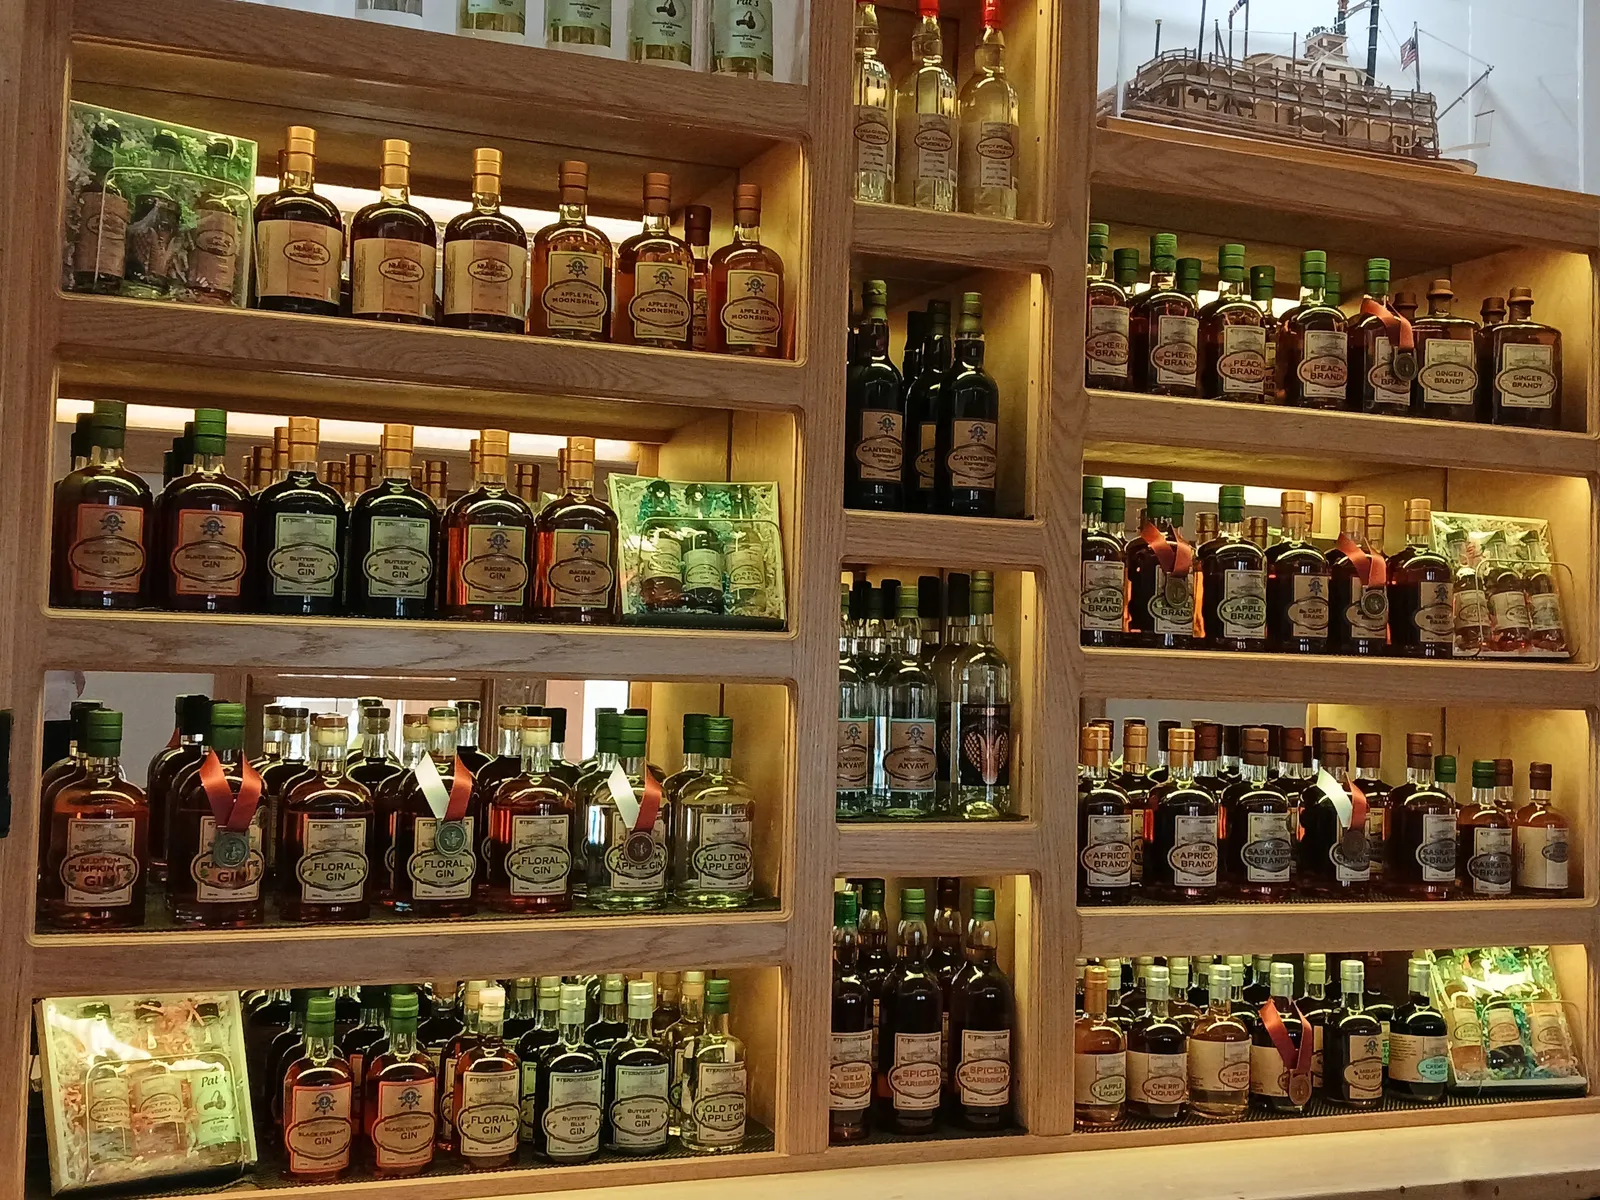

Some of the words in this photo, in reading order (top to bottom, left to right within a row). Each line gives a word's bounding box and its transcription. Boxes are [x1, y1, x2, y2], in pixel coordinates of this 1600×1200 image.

[561, 291, 581, 299] APPLE
[552, 297, 599, 307] MOONSHINE
[648, 301, 666, 309] APPLE
[639, 307, 684, 317] MOONSHINE
[731, 314, 775, 322] MOONSHINE
[1233, 360, 1262, 368] PEACH
[1313, 364, 1343, 373] PEACH
[101, 556, 120, 565] GIN
[289, 555, 323, 563] BUTTERFLY
[384, 558, 417, 566] BUTTERFLY
[202, 560, 220, 568] GIN
[297, 568, 316, 576] GIN
[391, 571, 409, 579] GIN
[489, 572, 506, 580] GIN
[574, 575, 591, 583] GIN
[1092, 596, 1120, 604] APPLE
[1161, 608, 1192, 617] BRAND
[1234, 605, 1263, 613] APPLE
[521, 855, 561, 865] FLORAL
[706, 853, 727, 862] OLD
[728, 853, 748, 861] TOM
[68, 863, 114, 873] PUMPKIN
[115, 864, 132, 872] PIE
[313, 862, 357, 872] FLORAL
[424, 859, 465, 869] FLORAL
[649, 860, 663, 870] GIN
[701, 862, 734, 871] APPLE
[735, 861, 750, 871] GIN
[435, 868, 455, 878] GIN
[532, 865, 551, 875] GIN
[84, 875, 116, 887] GIN
[217, 871, 249, 884] GIN
[325, 872, 346, 882] GIN
[902, 1069, 938, 1078] SPICED
[970, 1066, 1007, 1075] SPICED
[706, 1105, 726, 1113] OLD
[728, 1103, 745, 1112] TOM
[470, 1114, 512, 1125] FLORAL
[701, 1114, 733, 1122] APPLE
[634, 1119, 651, 1128] GIN
[481, 1125, 501, 1135] GIN
[569, 1127, 586, 1135] GIN
[400, 1131, 418, 1140] GIN
[314, 1137, 332, 1145] GIN
